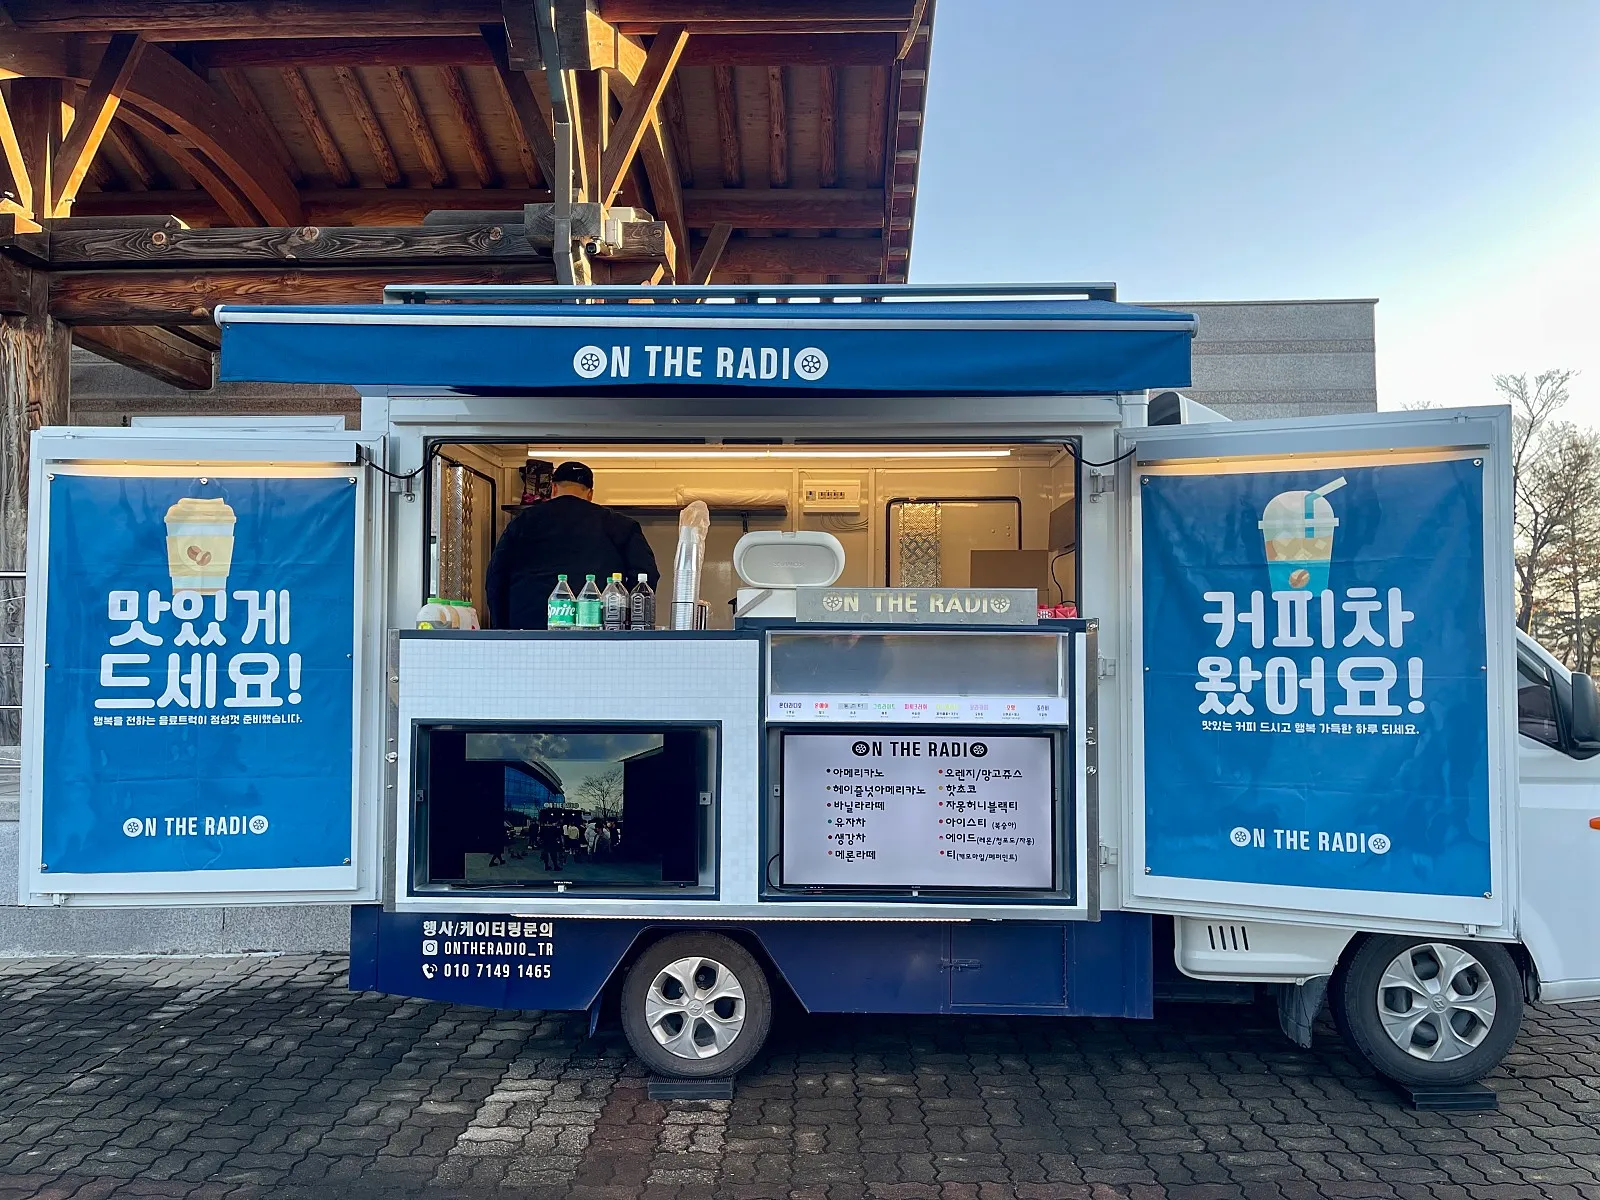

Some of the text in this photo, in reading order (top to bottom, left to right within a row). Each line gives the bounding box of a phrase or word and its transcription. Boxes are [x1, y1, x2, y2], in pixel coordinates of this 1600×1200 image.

[573, 345, 829, 380] ON THE RADIO
[823, 592, 1010, 613] ON THE RADIO
[108, 589, 290, 646] 맛있게
[548, 604, 575, 618] Sprite
[1203, 587, 1415, 649] 커피차
[94, 652, 302, 709] 드세요!
[1194, 656, 1425, 716] 왔어요!
[93, 713, 303, 726] 행복을 전하는 음료트럭이 정성껏 준비했습니다.
[1202, 720, 1420, 735] 맛있는 커피 드시고 행복 가득한 하루 되세요.
[852, 740, 988, 758] ON THE RADIO
[833, 768, 884, 778] 아메리카노
[945, 769, 1022, 781] 오렌지/망고쥬스
[833, 784, 926, 797] 헤이즐넛아메리카노
[946, 784, 976, 796] 핫초코
[834, 801, 885, 813] 바닐라라떼
[946, 801, 1018, 813] 자몽허니블랙티
[123, 814, 269, 838] ON THE RADIO
[835, 817, 866, 827] 유자차
[946, 818, 986, 827] 아이스티
[835, 833, 866, 845] 생강차
[1230, 826, 1391, 855] ON THE RADIO
[835, 850, 876, 862] 메론라떼
[423, 920, 553, 938] 행사/케이터링문의
[445, 942, 553, 956] ONTHERADIO_TR
[444, 964, 551, 978] 010 7149 1465
